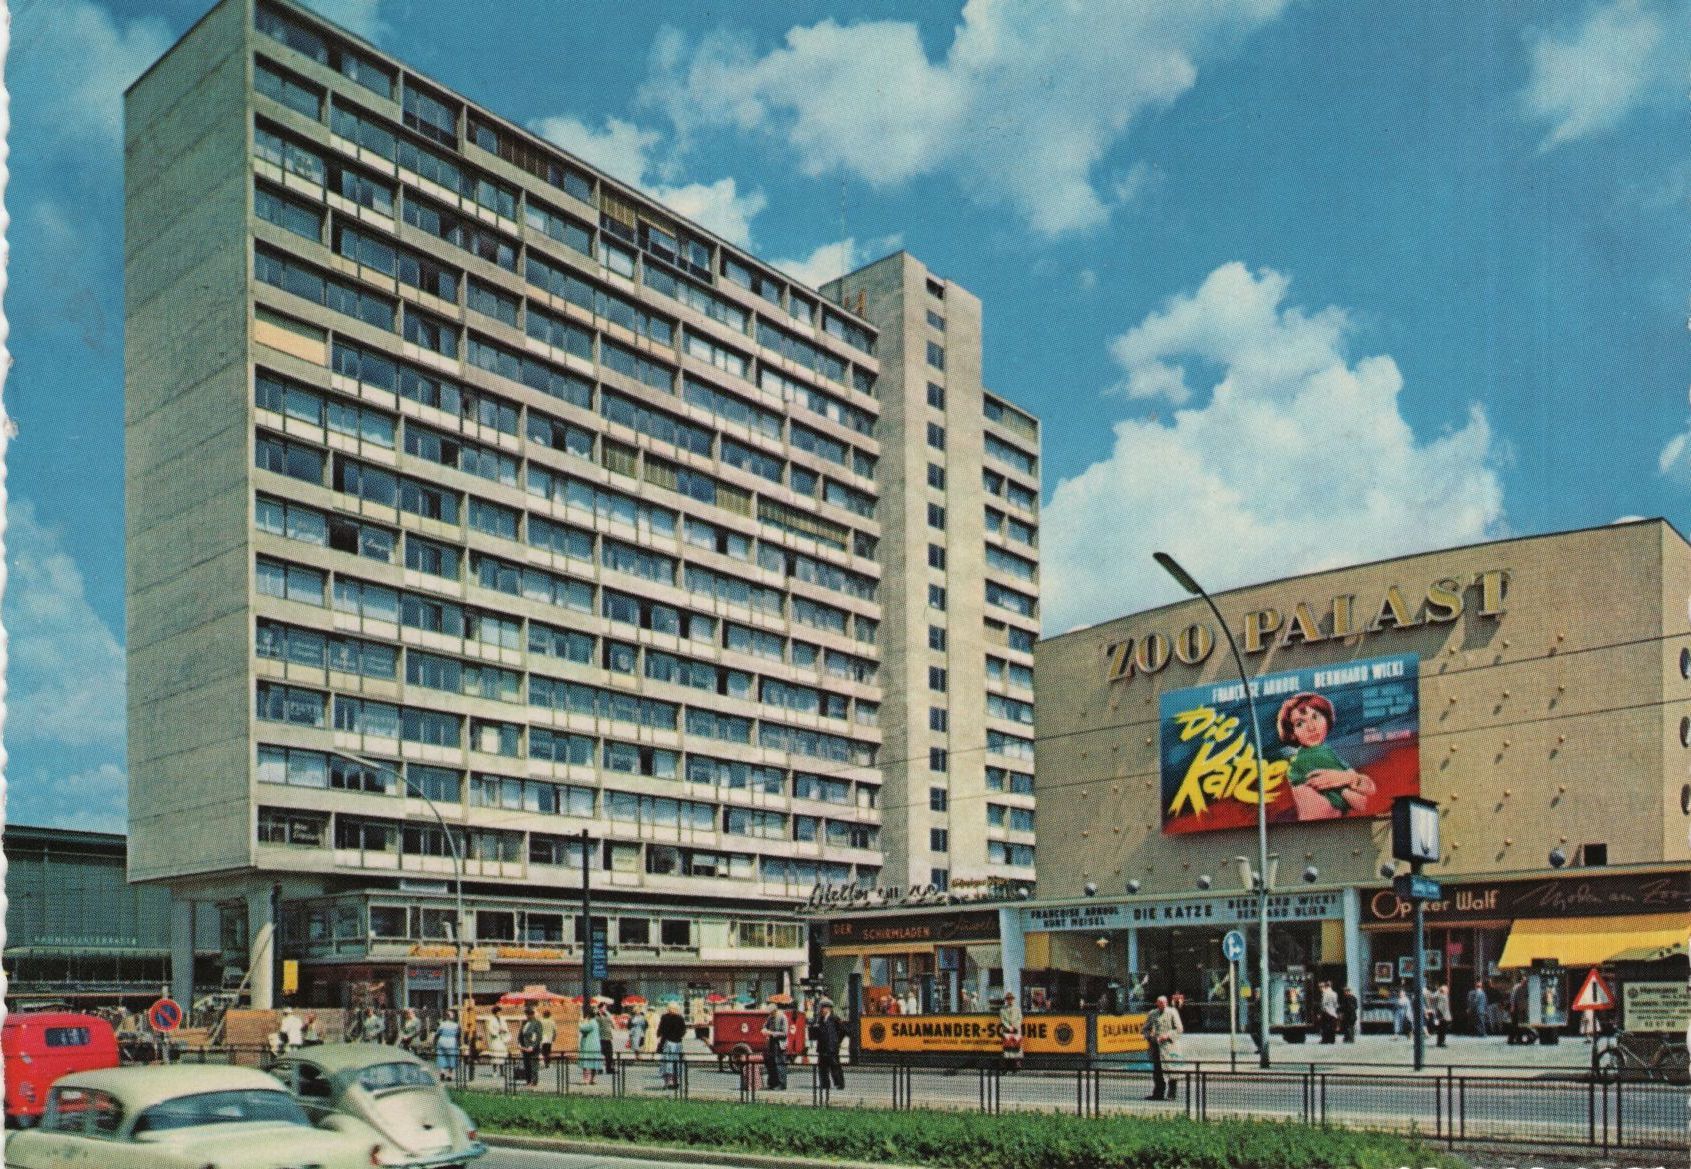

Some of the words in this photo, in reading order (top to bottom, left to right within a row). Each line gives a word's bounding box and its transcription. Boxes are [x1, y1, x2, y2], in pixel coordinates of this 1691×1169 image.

[1106, 624, 1215, 684] ZOO
[1243, 569, 1511, 653] PALAST
[1314, 665, 1368, 688] BERNHARD
[1373, 660, 1404, 679] WICKI
[1172, 705, 1240, 742] Die
[1167, 730, 1290, 819] Katze
[1134, 907, 1157, 920] DIE
[1165, 904, 1212, 919] KATZE
[1228, 899, 1289, 909] BERNARD
[1298, 895, 1336, 905] WICKI
[1237, 909, 1288, 919] BERARD
